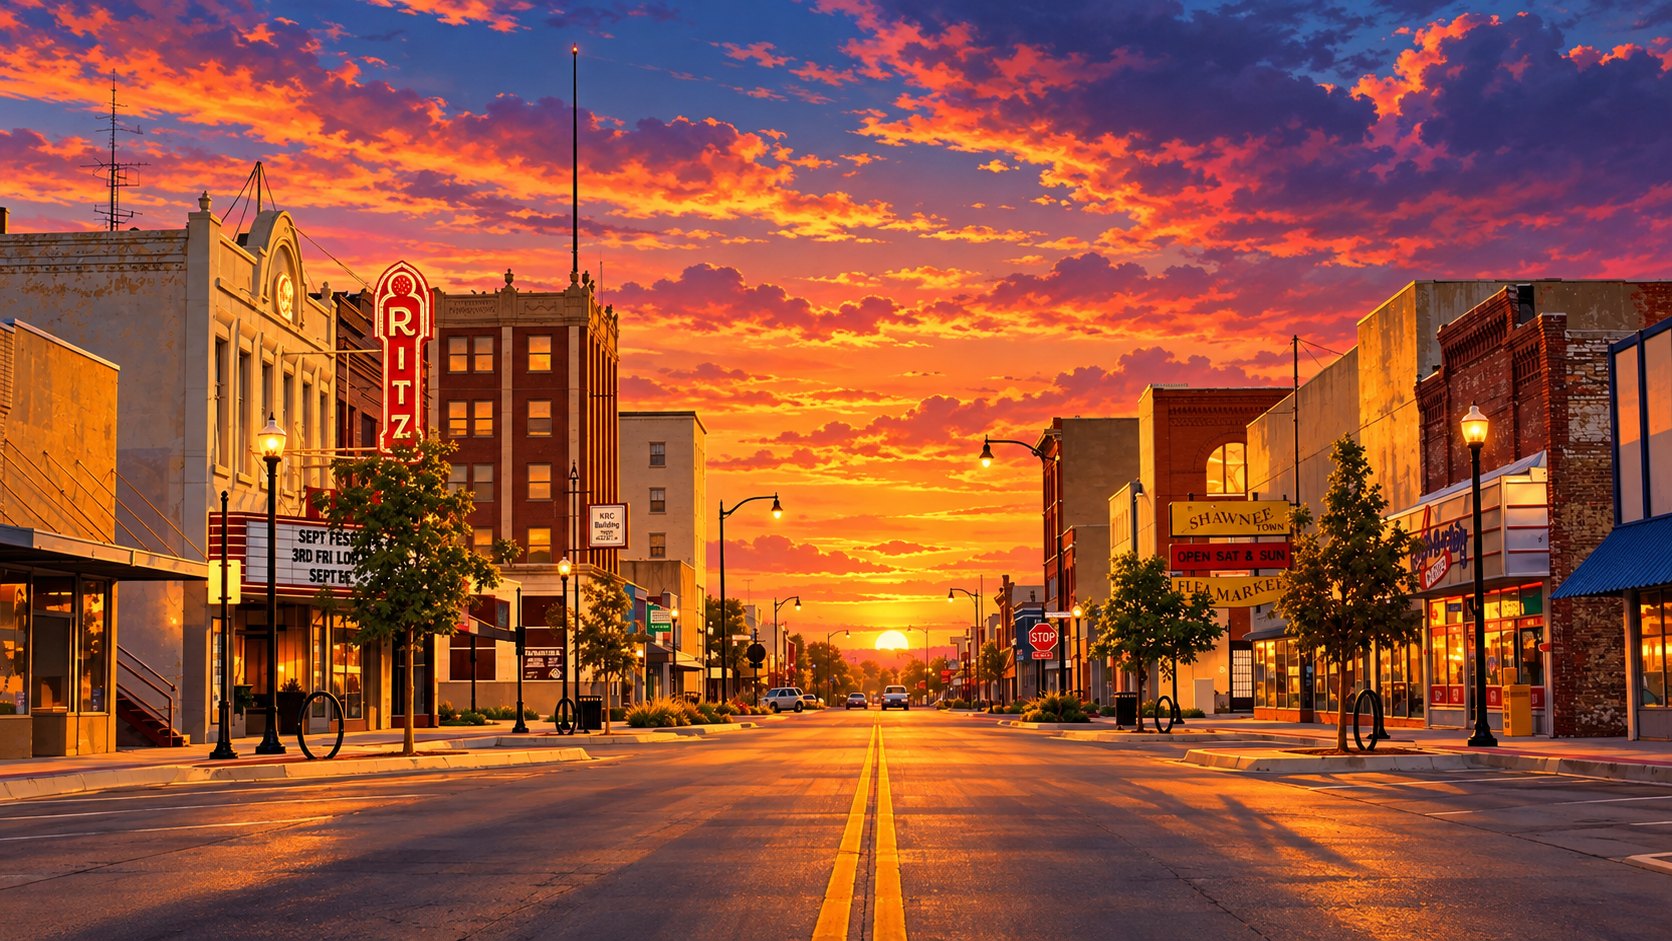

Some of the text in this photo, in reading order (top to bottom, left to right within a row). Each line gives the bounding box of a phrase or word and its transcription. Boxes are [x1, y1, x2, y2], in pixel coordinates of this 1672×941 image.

[388, 306, 416, 439] RITZ
[1189, 507, 1275, 530] SHAWNEE
[1256, 523, 1285, 532] TOWN
[298, 529, 326, 544] SEPT
[292, 548, 312, 562] 3RD
[316, 550, 332, 564] FRI
[1178, 550, 1286, 562] OPEN SAT & SUN
[1178, 580, 1213, 598] FLEA
[1032, 632, 1055, 642] STOP
